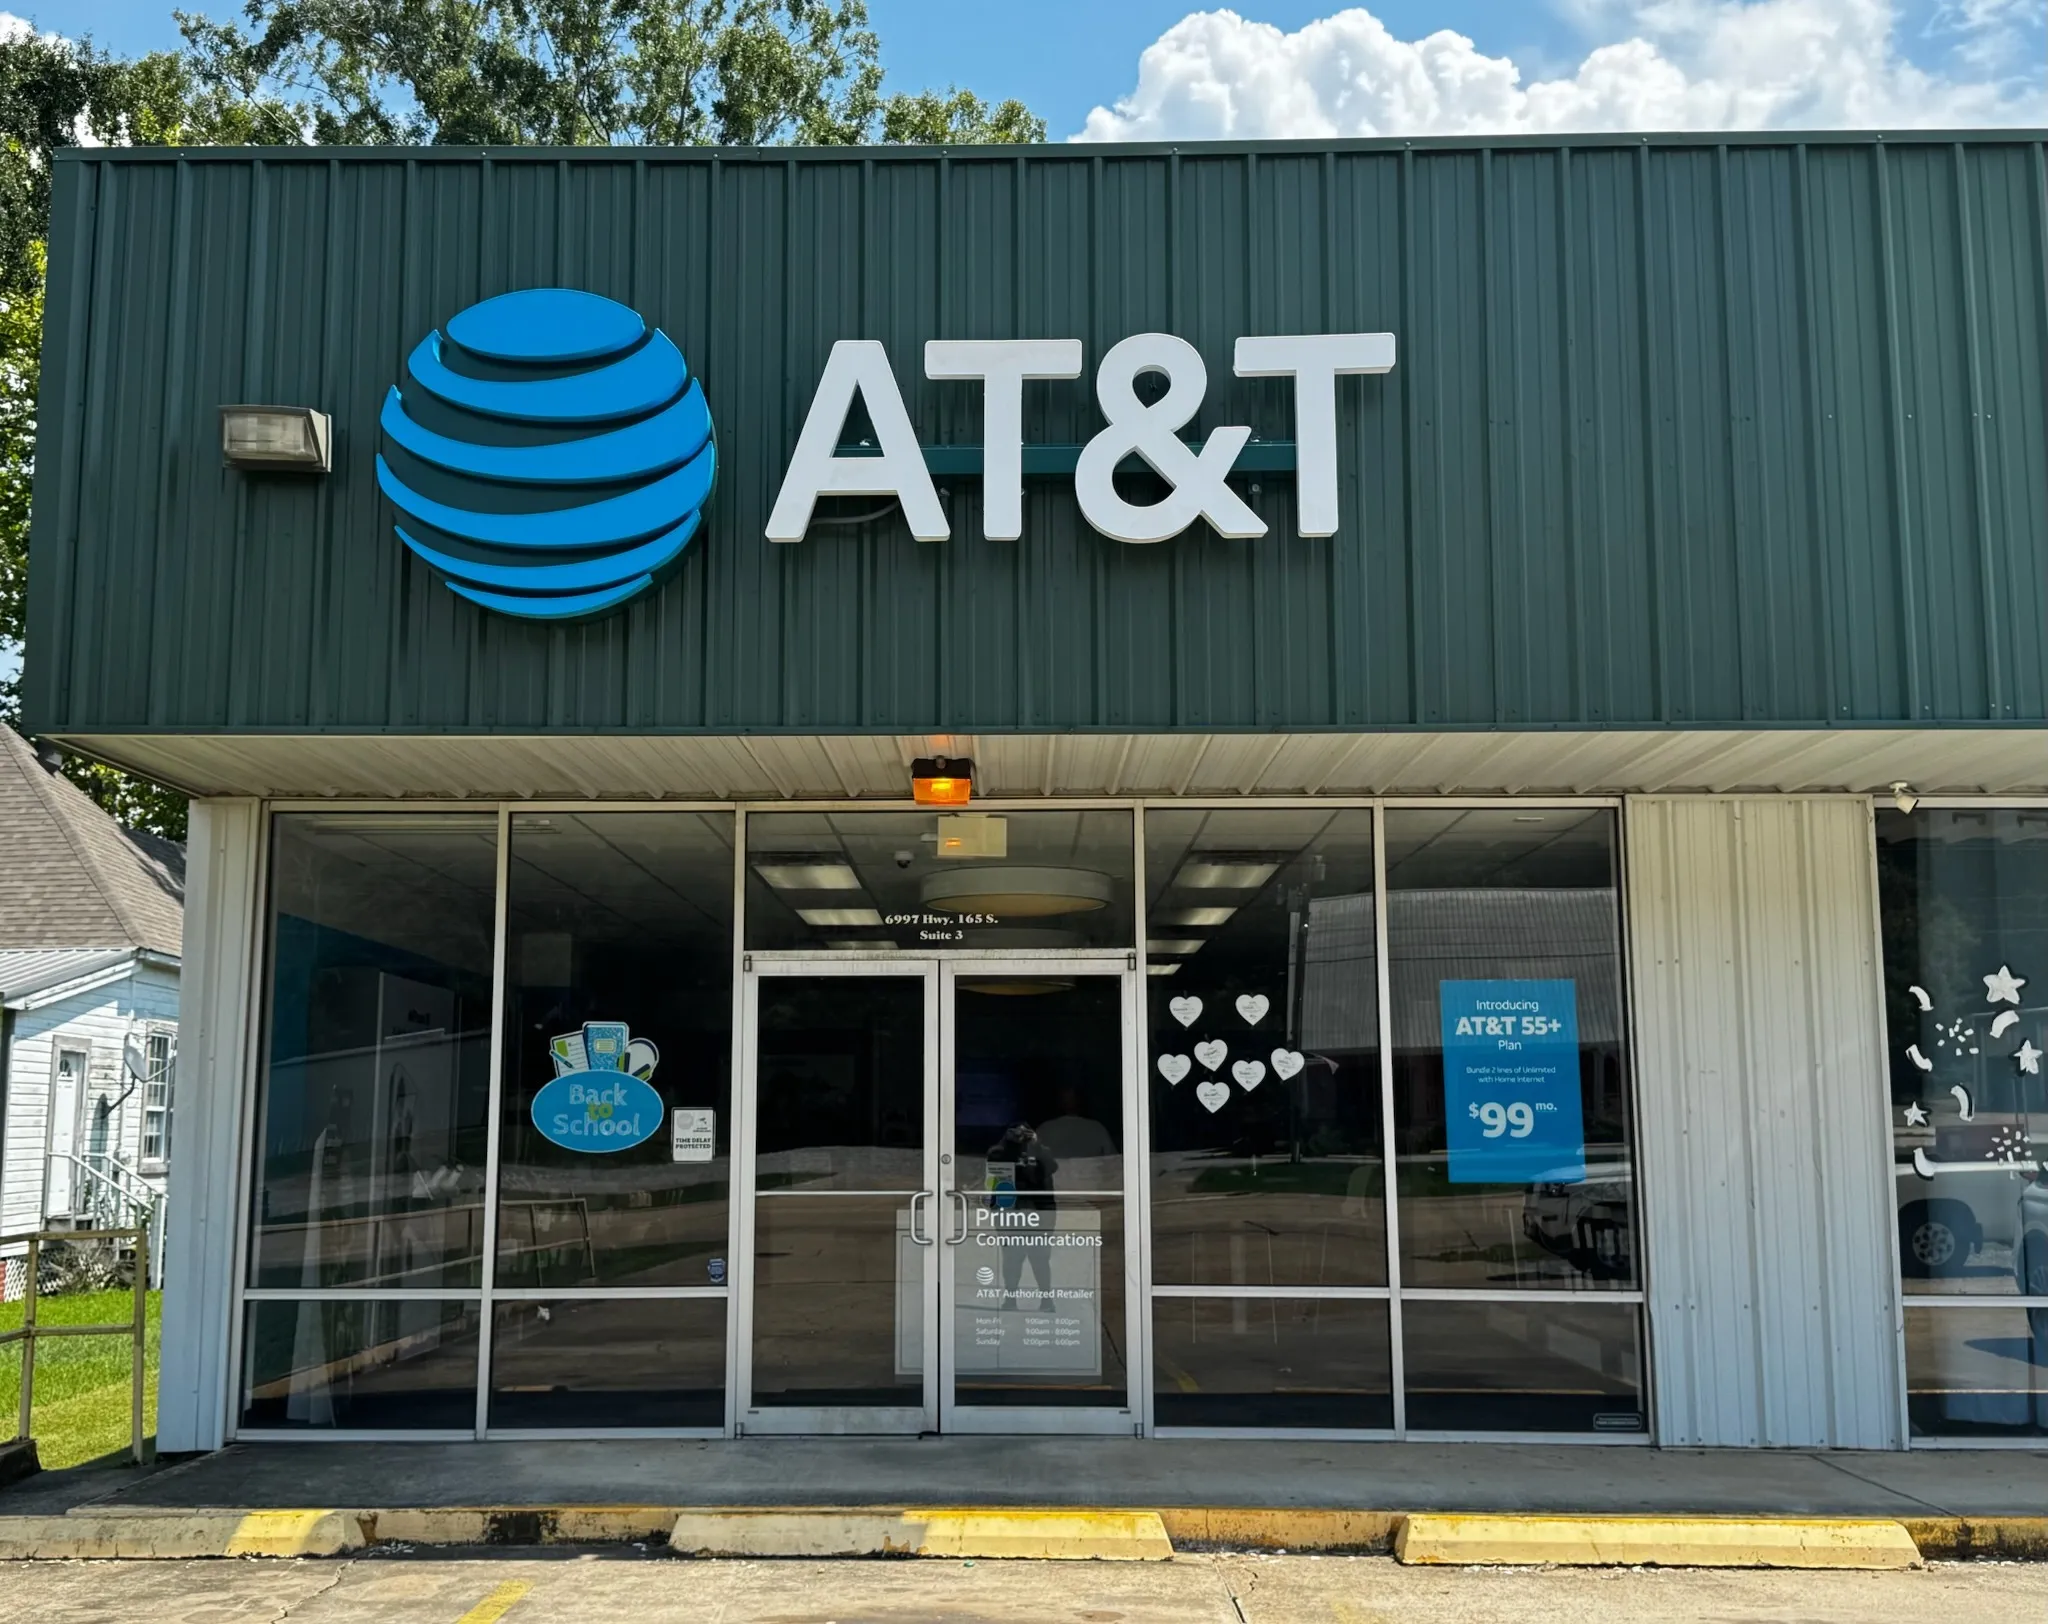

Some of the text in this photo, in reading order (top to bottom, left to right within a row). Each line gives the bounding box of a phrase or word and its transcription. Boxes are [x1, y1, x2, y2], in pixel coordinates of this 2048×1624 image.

[764, 331, 1397, 544] AT&T
[884, 913, 999, 925] 6997 Hwy. 165 S.
[919, 930, 963, 940] Suite 3
[1476, 1000, 1539, 1012] Introducing
[1455, 1016, 1562, 1036] AT&T 55+
[1498, 1039, 1522, 1050] Plan
[1466, 1066, 1490, 1074] Bundle
[1514, 1066, 1521, 1074] of
[1522, 1066, 1556, 1074] Unlimited
[569, 1083, 628, 1106] Back
[588, 1099, 613, 1121] to
[1535, 1102, 1558, 1111] mo.
[553, 1112, 641, 1137] School
[976, 1208, 1040, 1227] Prime
[976, 1233, 1103, 1247] Communications
[976, 1289, 1094, 1299] AT&T Authorized Retailer
[975, 1328, 1005, 1336] Saturday
